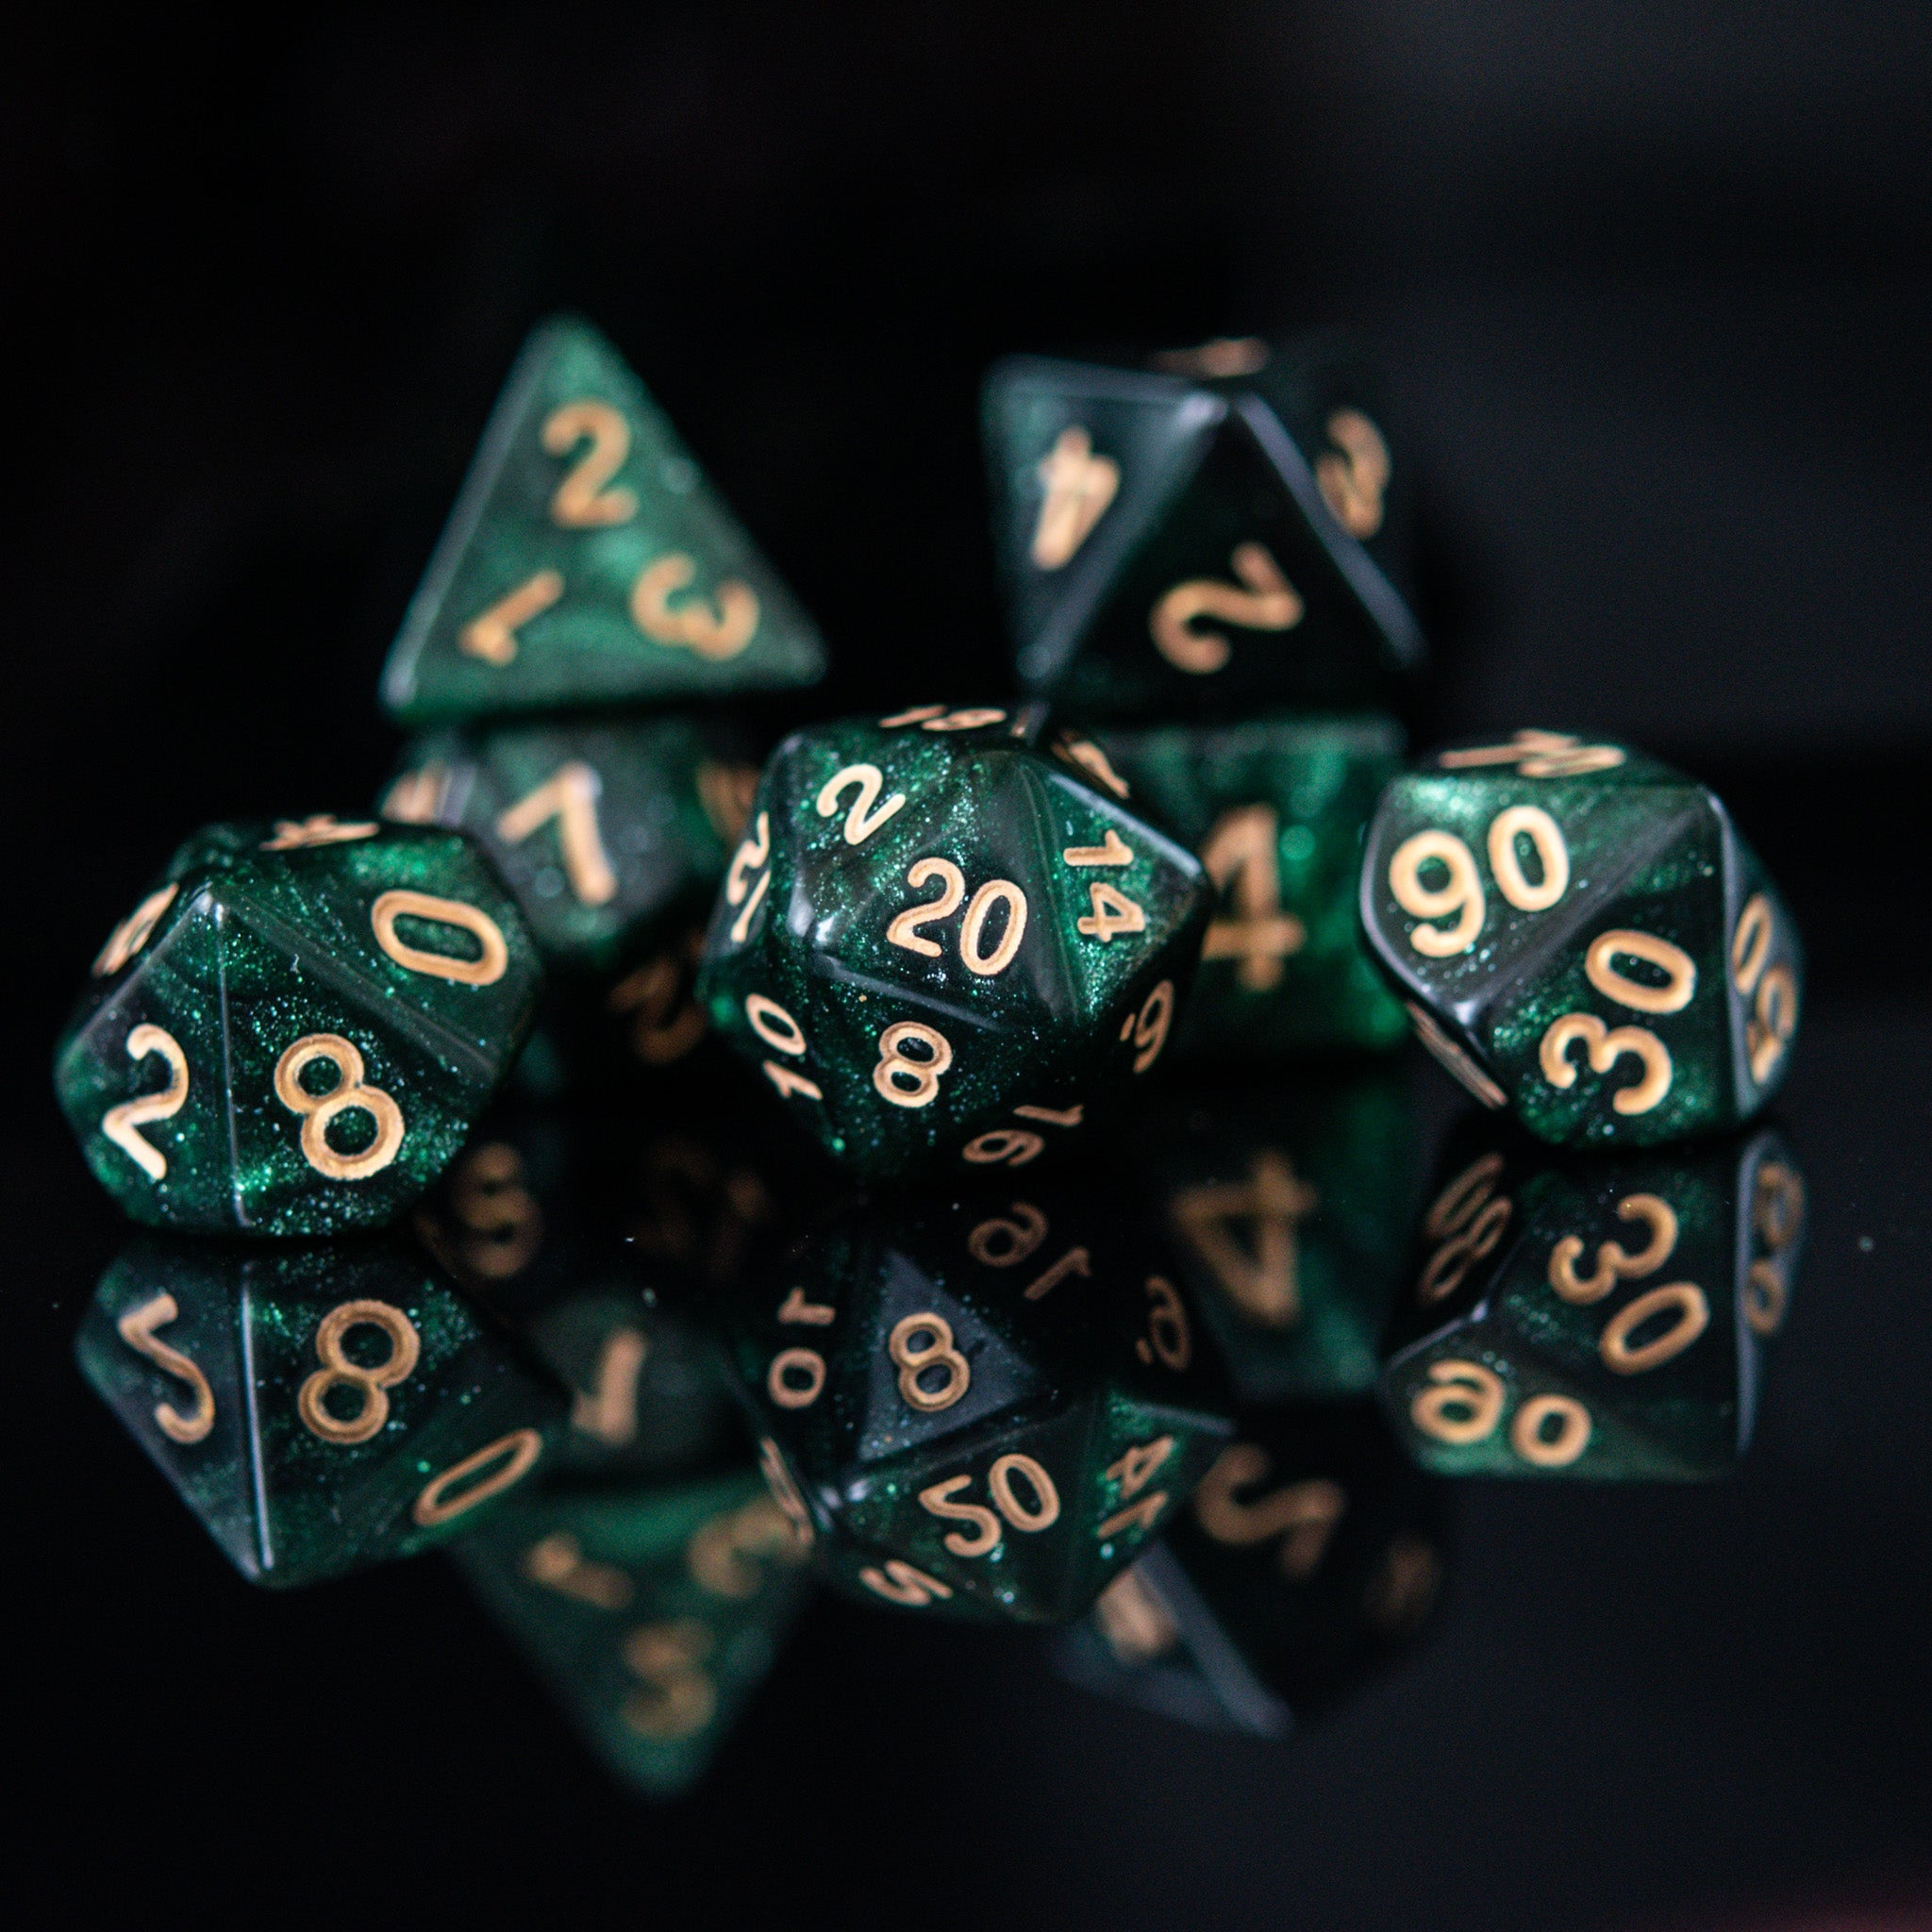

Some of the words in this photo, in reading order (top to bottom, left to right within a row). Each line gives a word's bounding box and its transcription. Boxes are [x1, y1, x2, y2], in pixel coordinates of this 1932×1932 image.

[541, 400, 639, 528] 2
[458, 571, 563, 665] 1
[629, 553, 760, 661] 3
[1149, 541, 1305, 674] 2
[817, 763, 906, 846] 2
[371, 890, 508, 986] 0
[887, 857, 1028, 976] 20
[1063, 828, 1145, 943] 14
[1200, 804, 1307, 992] 4
[1389, 805, 1570, 958] 90
[745, 993, 824, 1101] 10
[873, 1022, 954, 1108] 8
[1539, 928, 1696, 1116] 30
[102, 1024, 190, 1181] 2
[274, 1034, 406, 1181] 8
[962, 1105, 1085, 1168] 16
